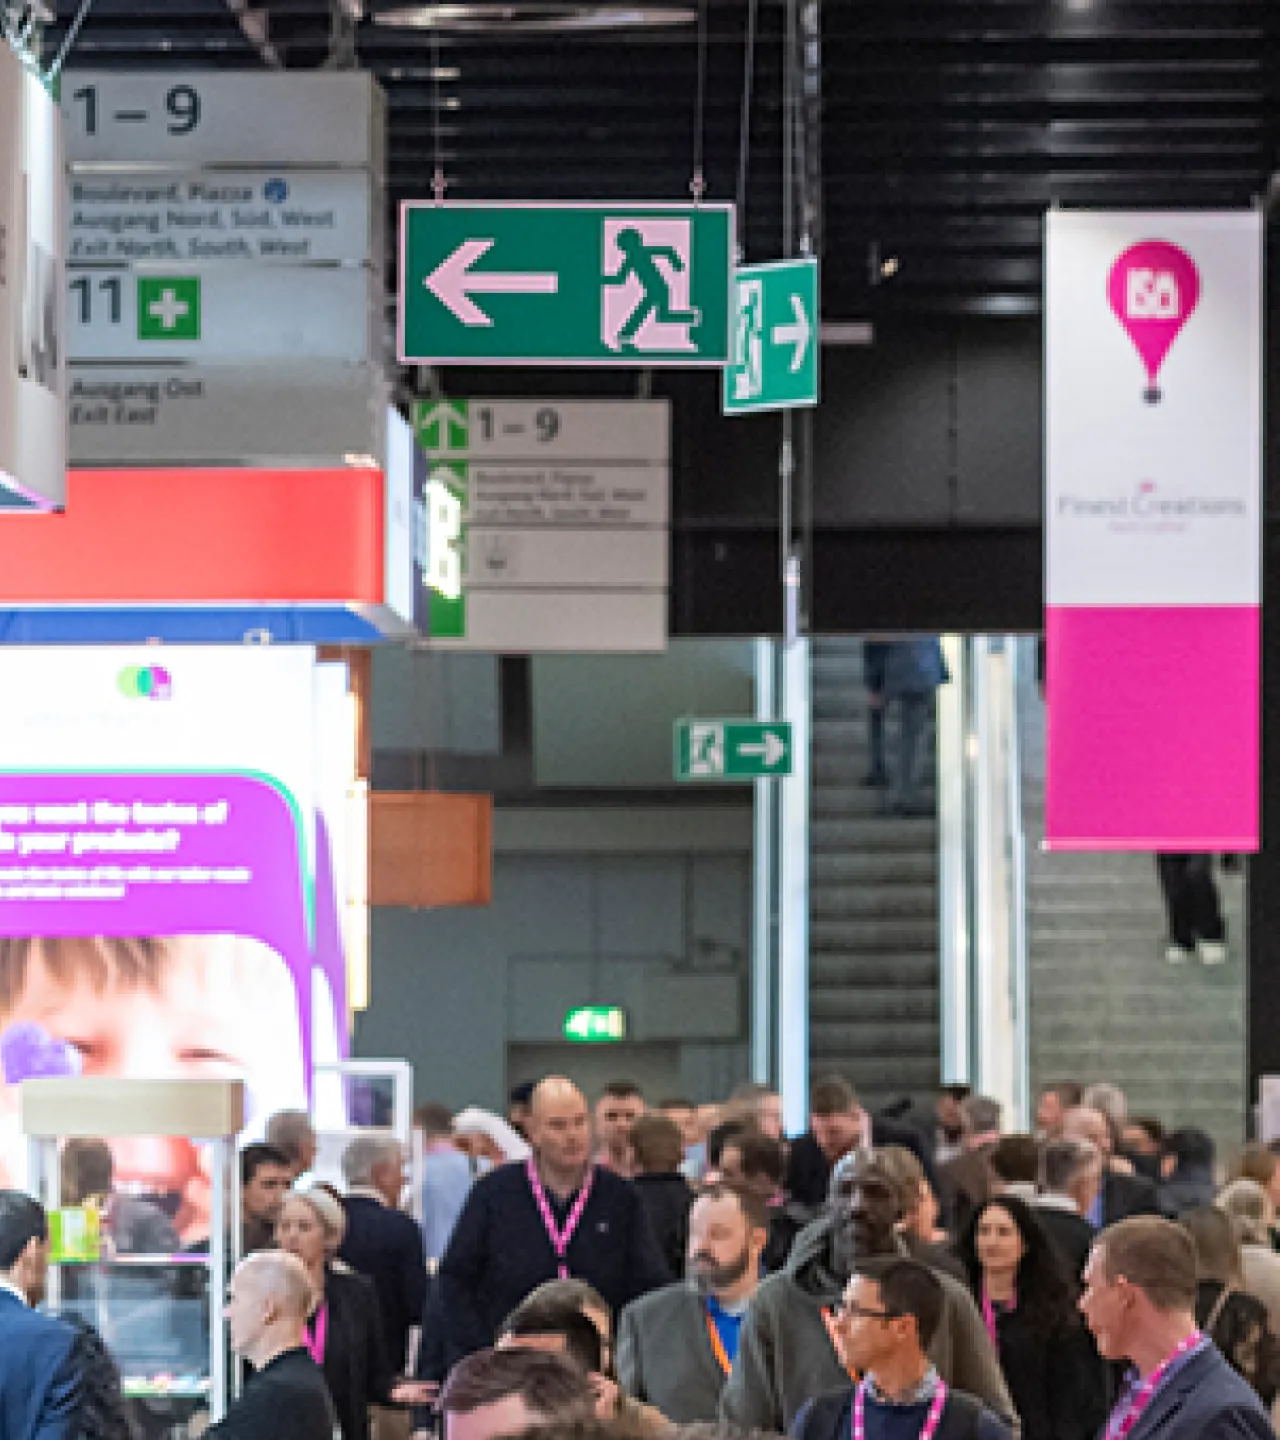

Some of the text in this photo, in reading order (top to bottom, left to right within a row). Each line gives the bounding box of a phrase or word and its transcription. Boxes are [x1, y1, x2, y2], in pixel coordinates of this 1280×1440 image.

[72, 85, 99, 135] 1
[165, 84, 202, 137] 9
[72, 211, 160, 234] Ausgang
[281, 210, 335, 230] West
[69, 278, 123, 324] 11
[69, 378, 159, 404] Ausgang
[477, 407, 495, 442] 1
[534, 407, 562, 444] 9
